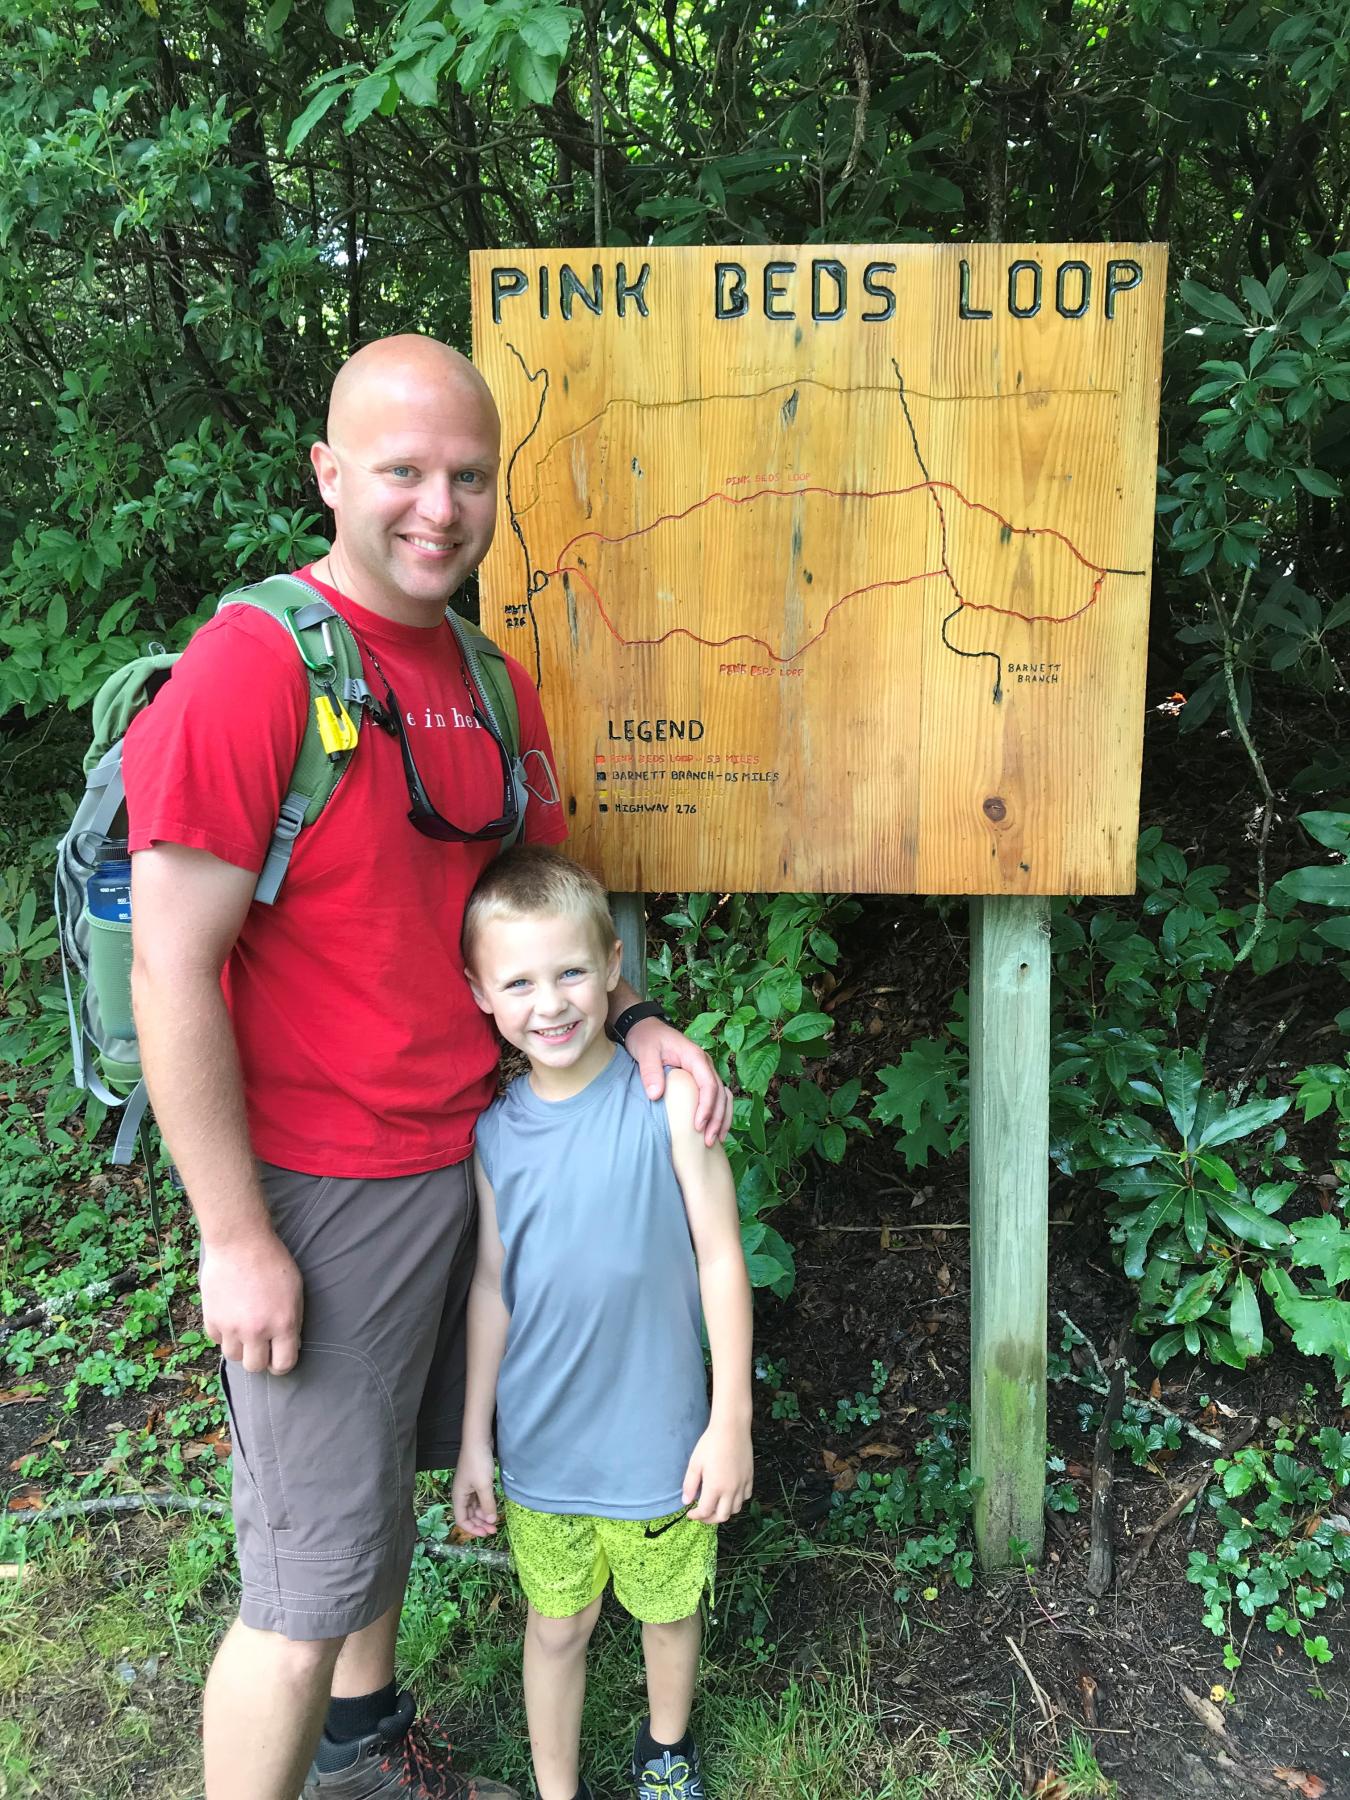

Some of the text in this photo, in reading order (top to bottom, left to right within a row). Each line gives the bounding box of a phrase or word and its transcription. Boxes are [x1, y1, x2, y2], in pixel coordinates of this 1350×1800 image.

[491, 258, 1144, 324] PINK BEDS LOOP
[726, 472, 811, 486] PINK BEDS LOOP
[1008, 663, 1062, 673] BARNETT
[1017, 674, 1058, 684] BRANCH
[424, 707, 446, 728] in
[608, 719, 705, 743] LEGEND
[725, 754, 760, 766] MILES
[612, 769, 667, 781] BARNETT
[741, 771, 780, 782] MILES
[615, 803, 698, 814] HIGHWAY 276
